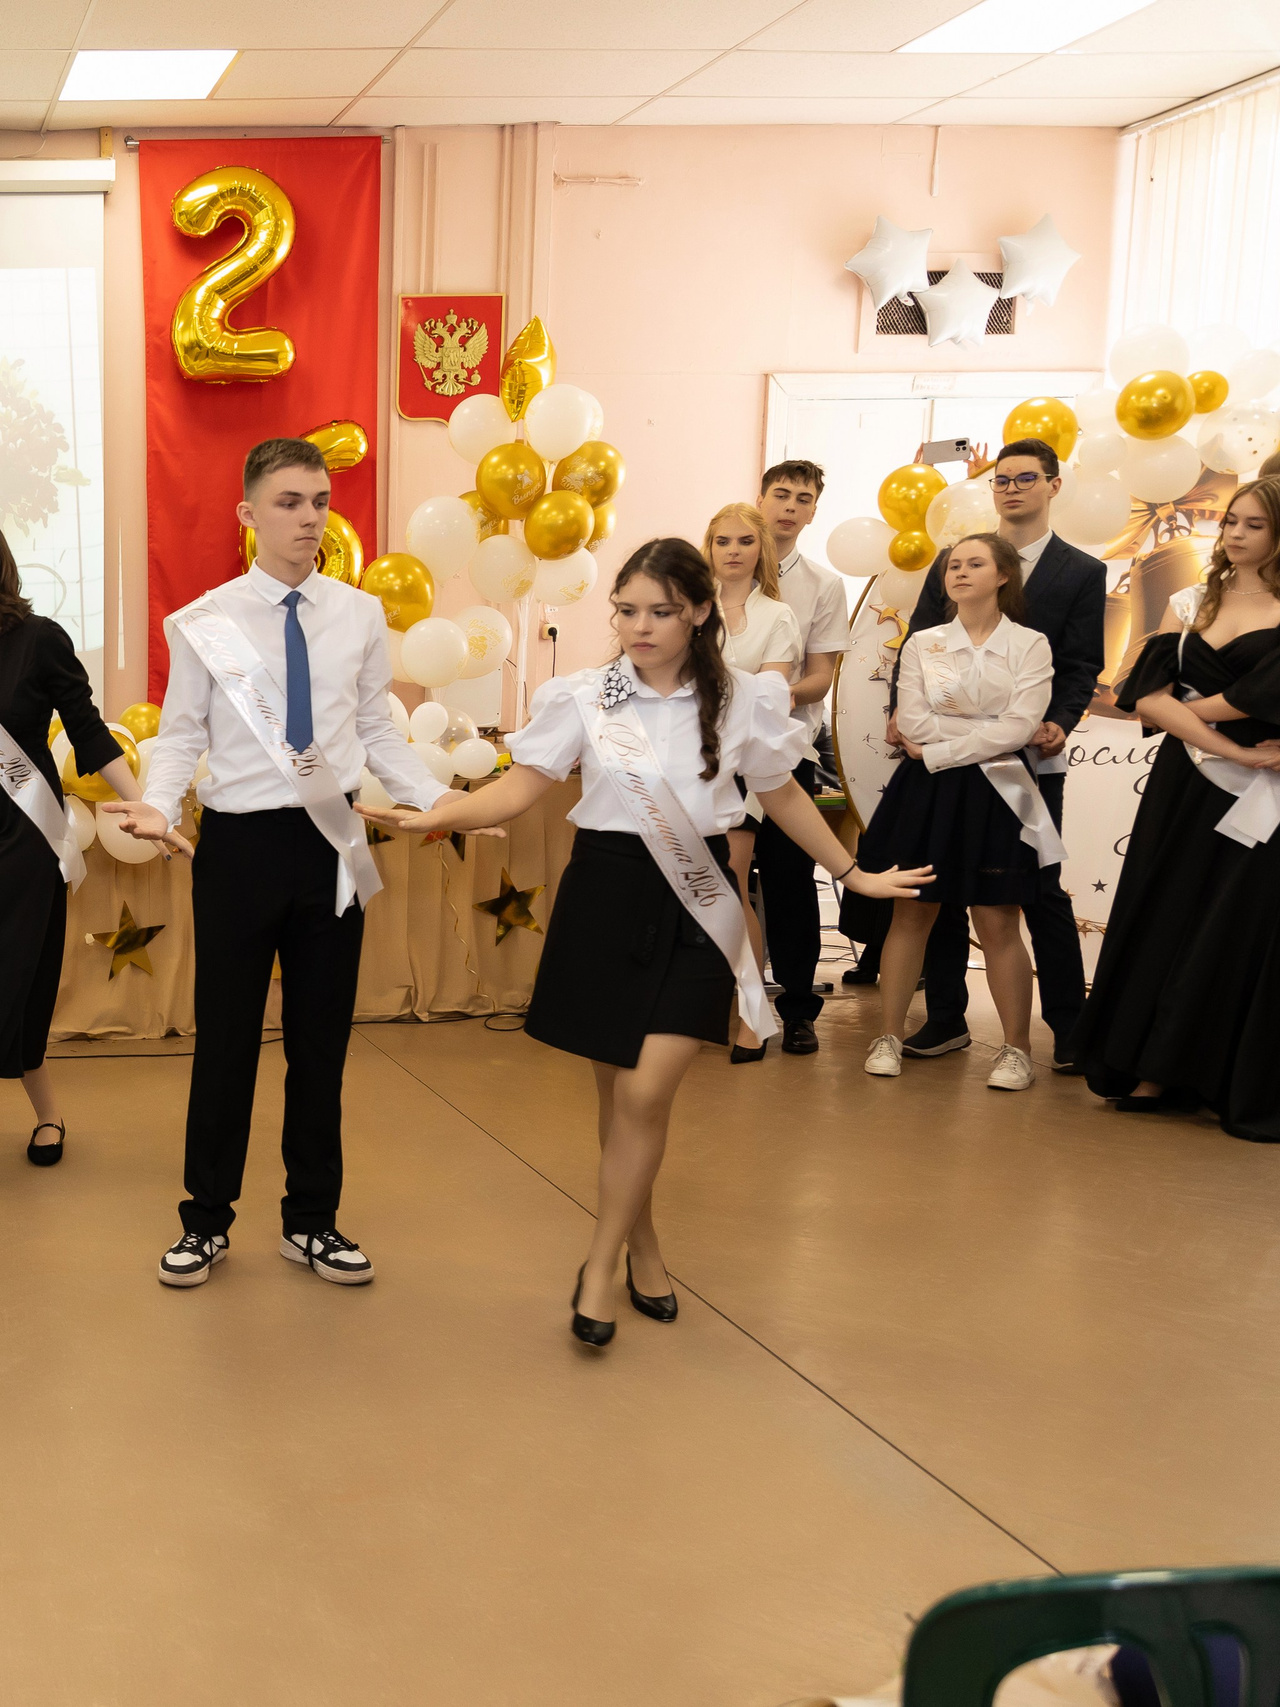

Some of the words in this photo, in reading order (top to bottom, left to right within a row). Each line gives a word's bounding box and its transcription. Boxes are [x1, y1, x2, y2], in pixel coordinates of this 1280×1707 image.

[170, 165, 296, 384] 2
[0, 757, 38, 789] 2026
[599, 722, 693, 866] Выпускница
[679, 865, 727, 907] 2026
